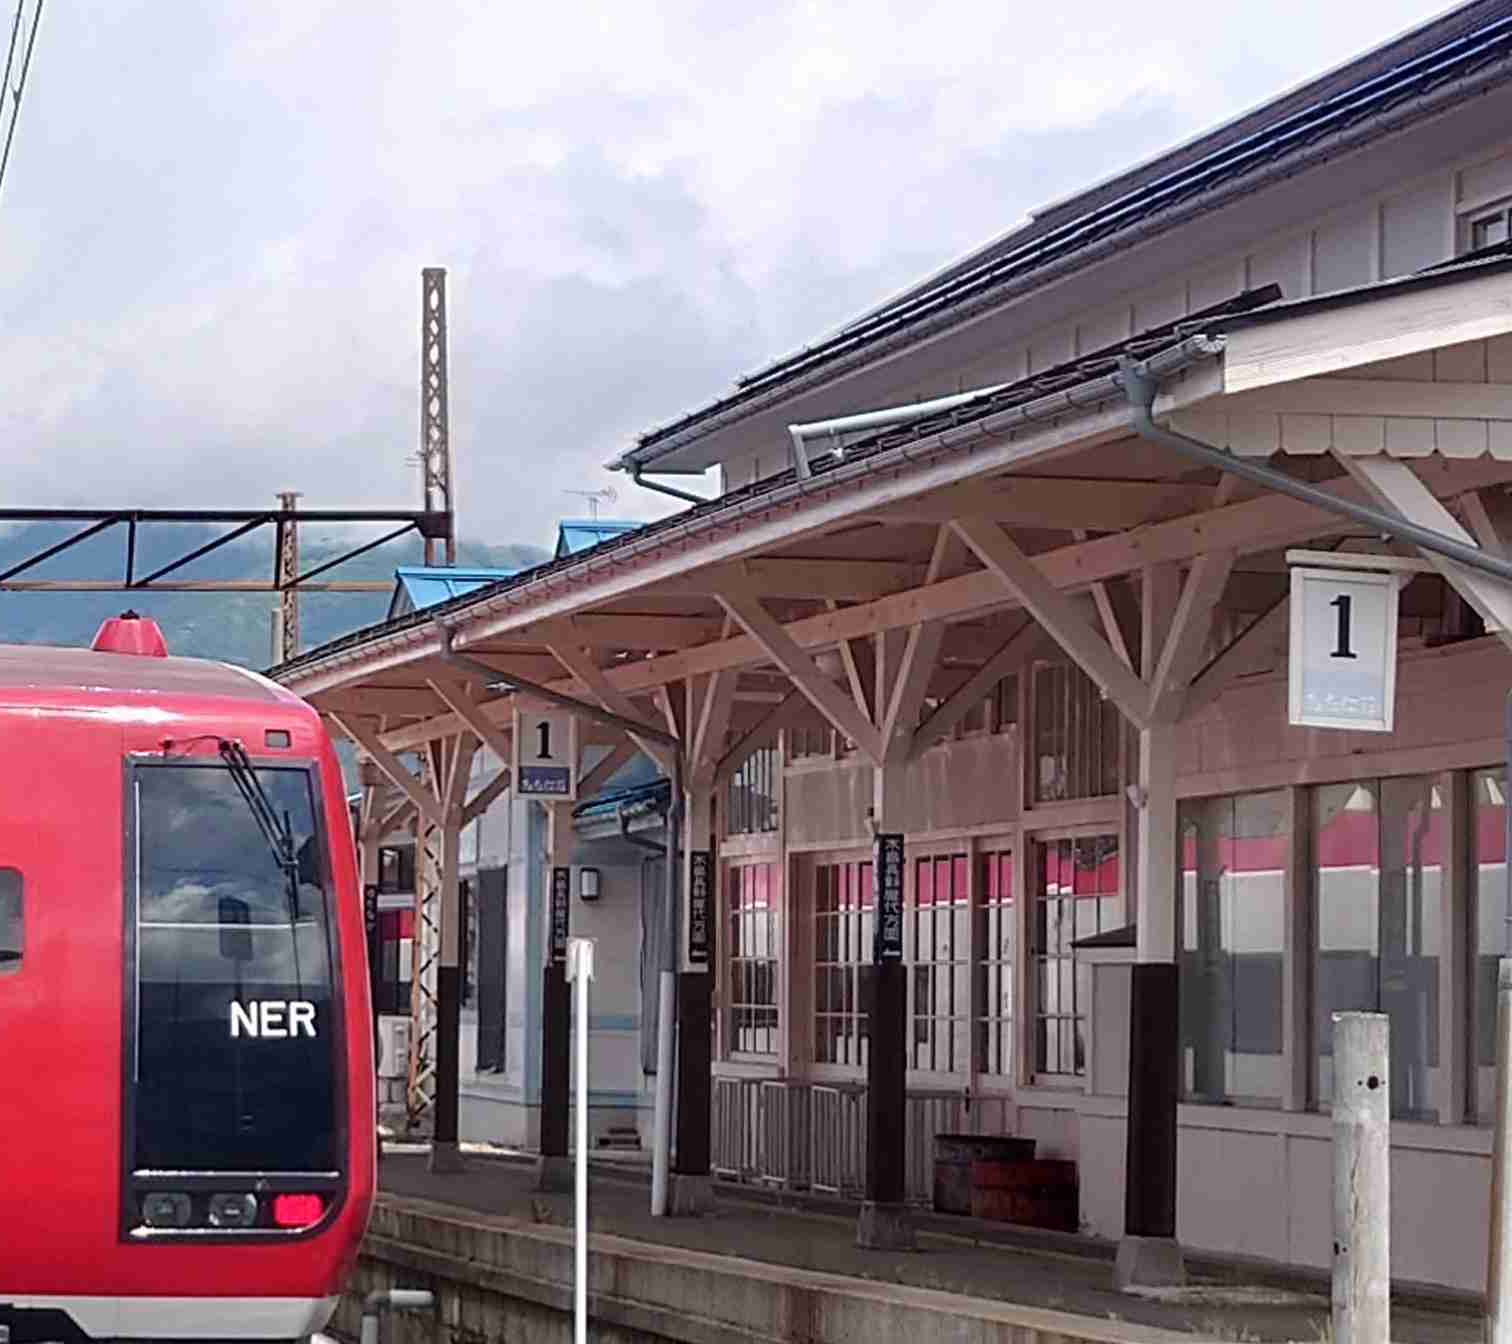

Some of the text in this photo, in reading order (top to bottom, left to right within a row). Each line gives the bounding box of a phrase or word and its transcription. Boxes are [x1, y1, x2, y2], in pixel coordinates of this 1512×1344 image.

[1330, 596, 1357, 659] 1
[536, 722, 552, 759] 1
[231, 1001, 317, 1037] NER
